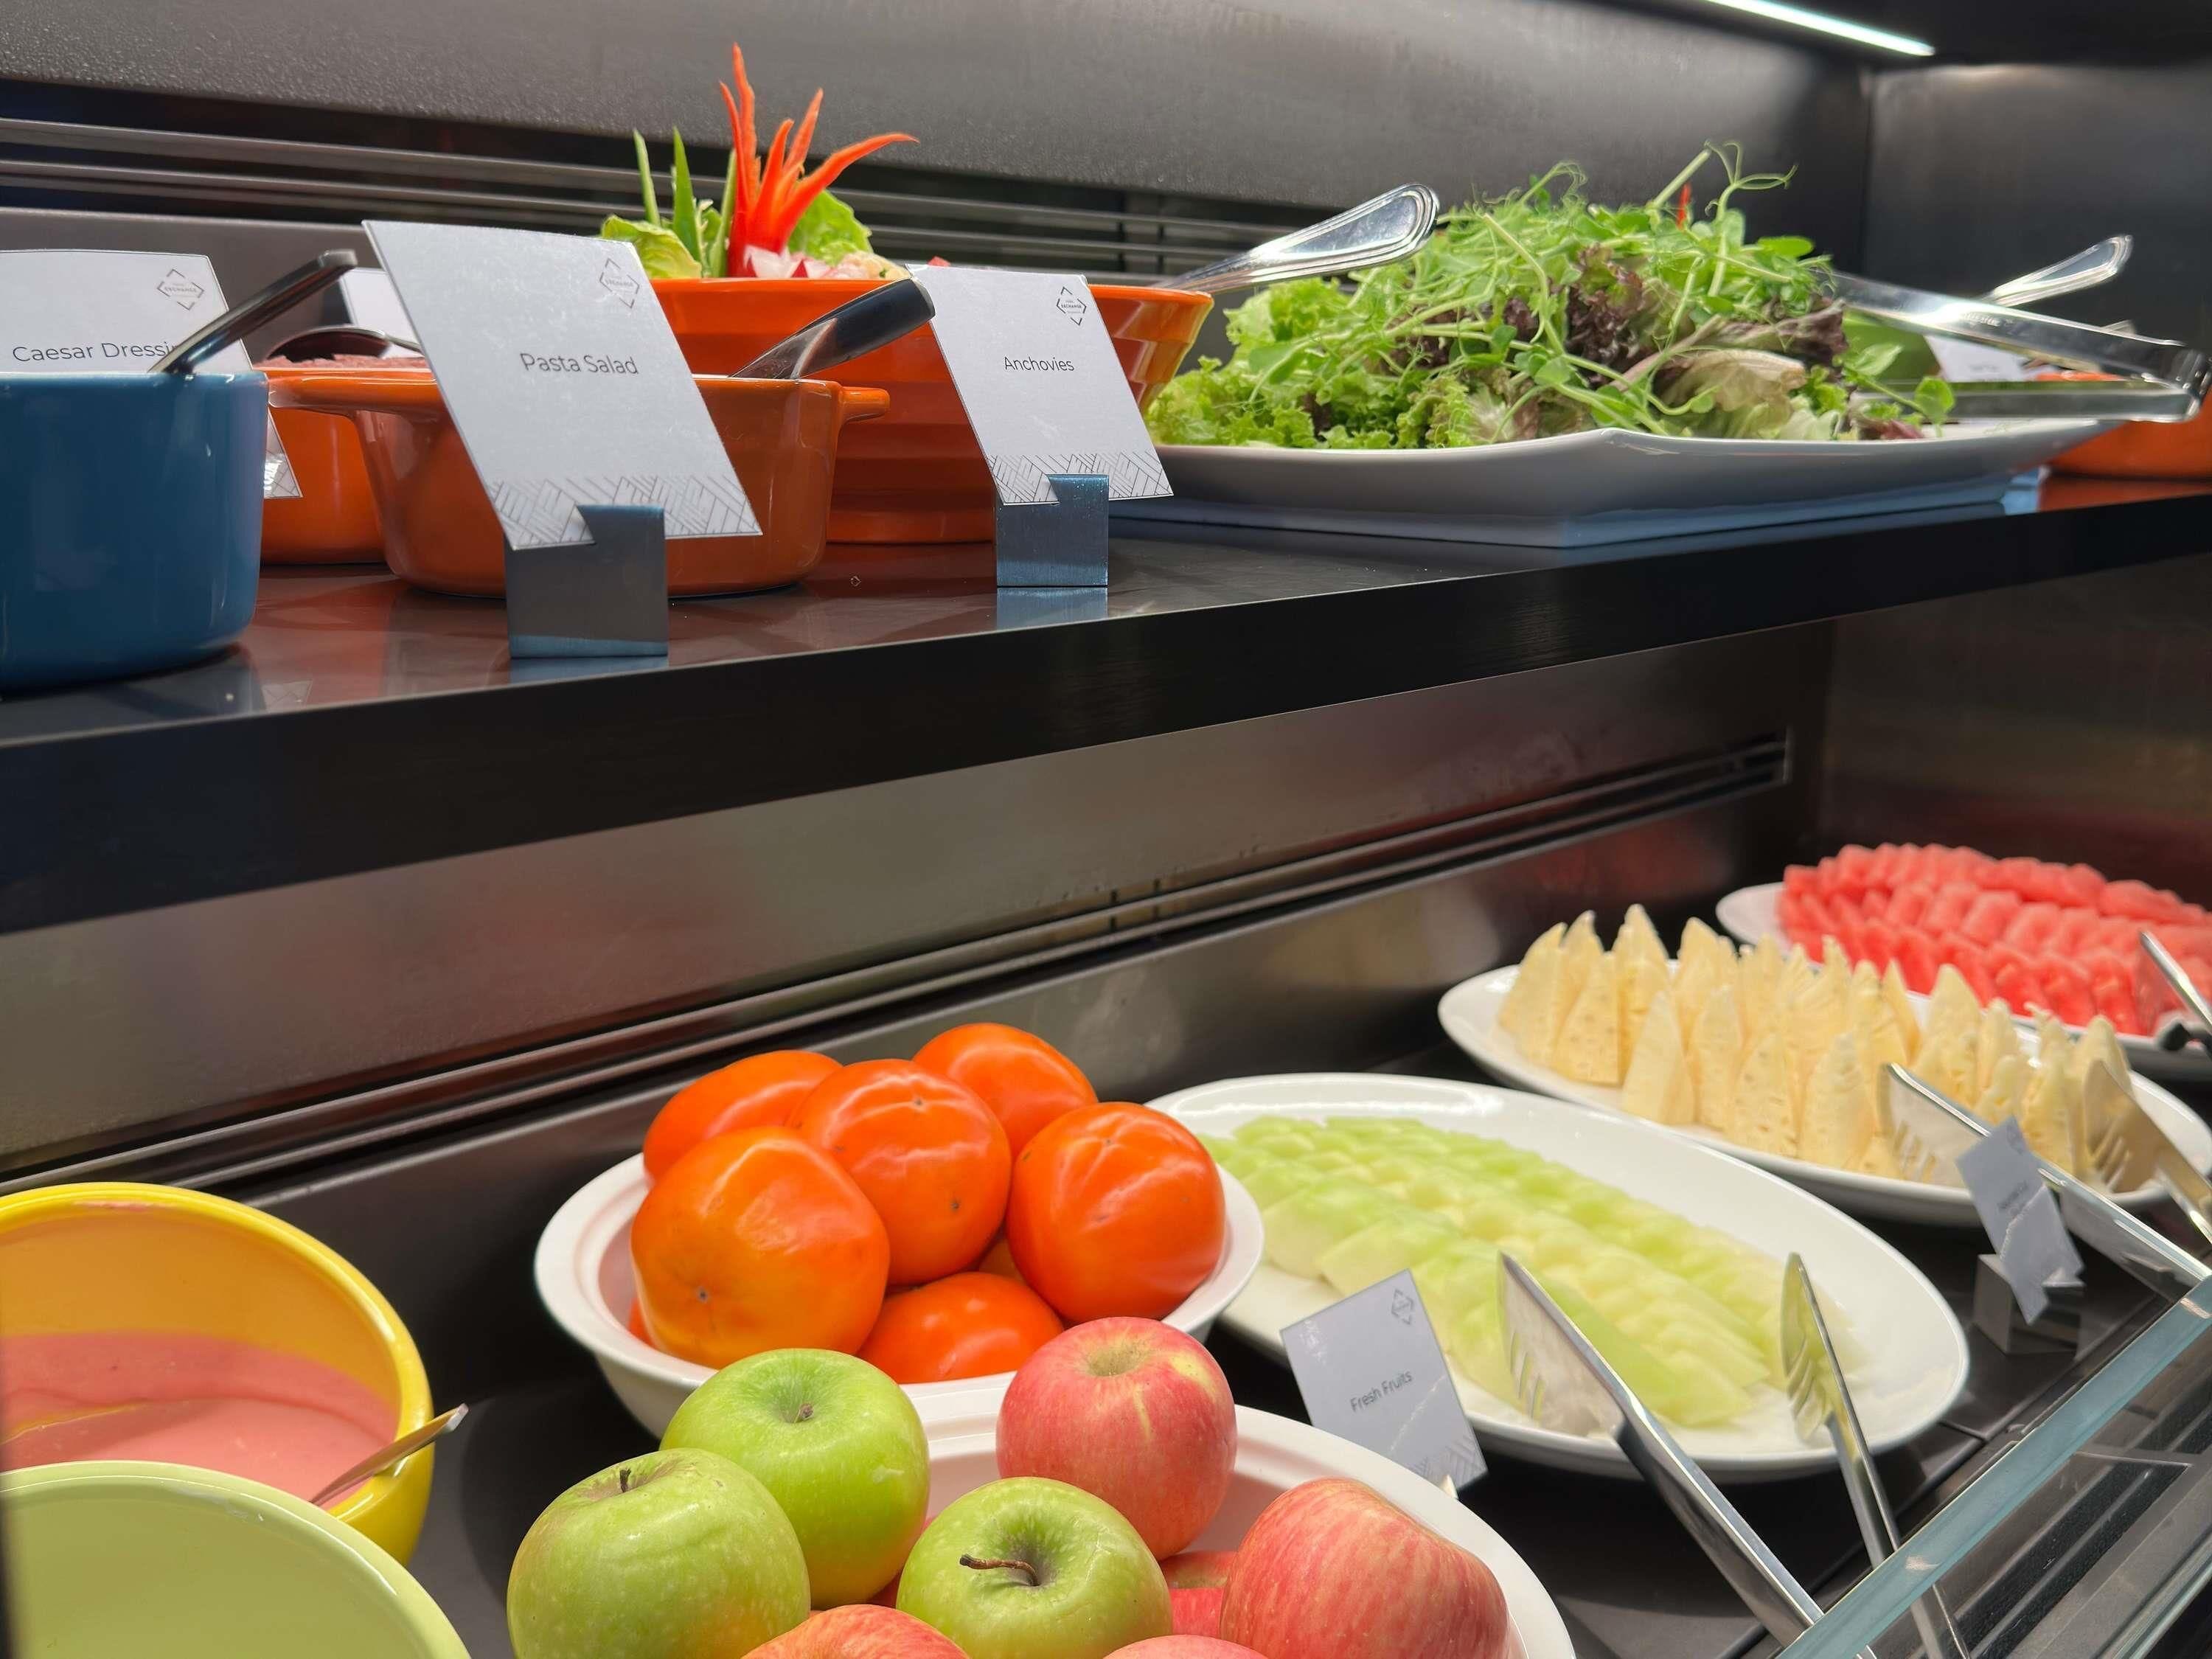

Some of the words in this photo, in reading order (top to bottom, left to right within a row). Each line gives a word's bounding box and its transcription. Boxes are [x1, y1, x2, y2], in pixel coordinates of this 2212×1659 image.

[13, 346, 94, 362] Caesar
[101, 341, 178, 358] Dressi
[520, 352, 581, 372] Pasta
[583, 354, 639, 375] Salad
[1004, 356, 1074, 371] Anchovies
[1350, 1387, 1382, 1413] Fresh
[1381, 1371, 1412, 1396] Fruits
